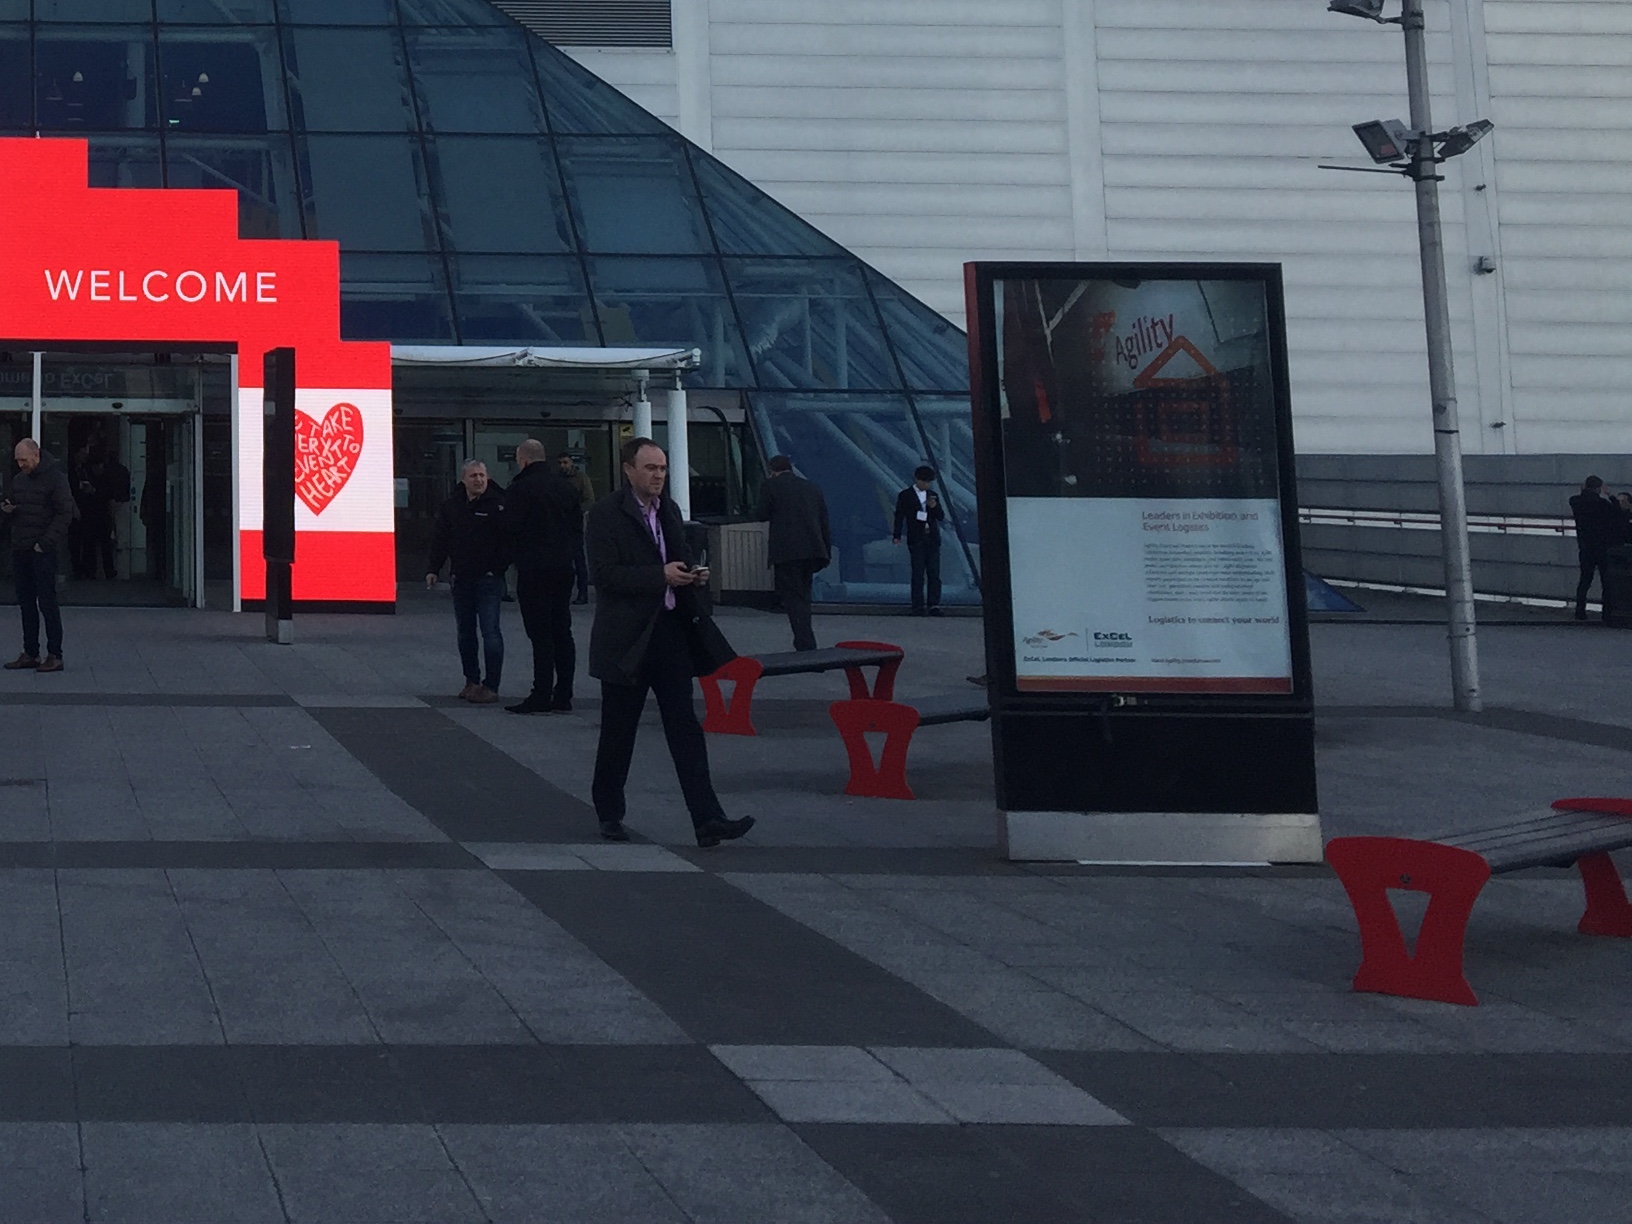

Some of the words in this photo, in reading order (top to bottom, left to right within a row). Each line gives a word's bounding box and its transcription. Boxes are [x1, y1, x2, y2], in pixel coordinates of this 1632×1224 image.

[44, 270, 277, 303] WELCOME
[1116, 313, 1173, 370] Agility
[309, 406, 354, 437] TAKE
[295, 433, 331, 456] ERY
[343, 434, 360, 453] TO
[300, 456, 351, 508] HEART
[1142, 512, 1180, 521] Leaders
[1192, 511, 1238, 521] Exhibition
[1240, 512, 1259, 521] and
[1142, 522, 1170, 531] Event
[1172, 523, 1209, 533] Logistics
[1149, 616, 1186, 625] Logistics
[1232, 617, 1252, 625] your
[1254, 616, 1280, 624] world
